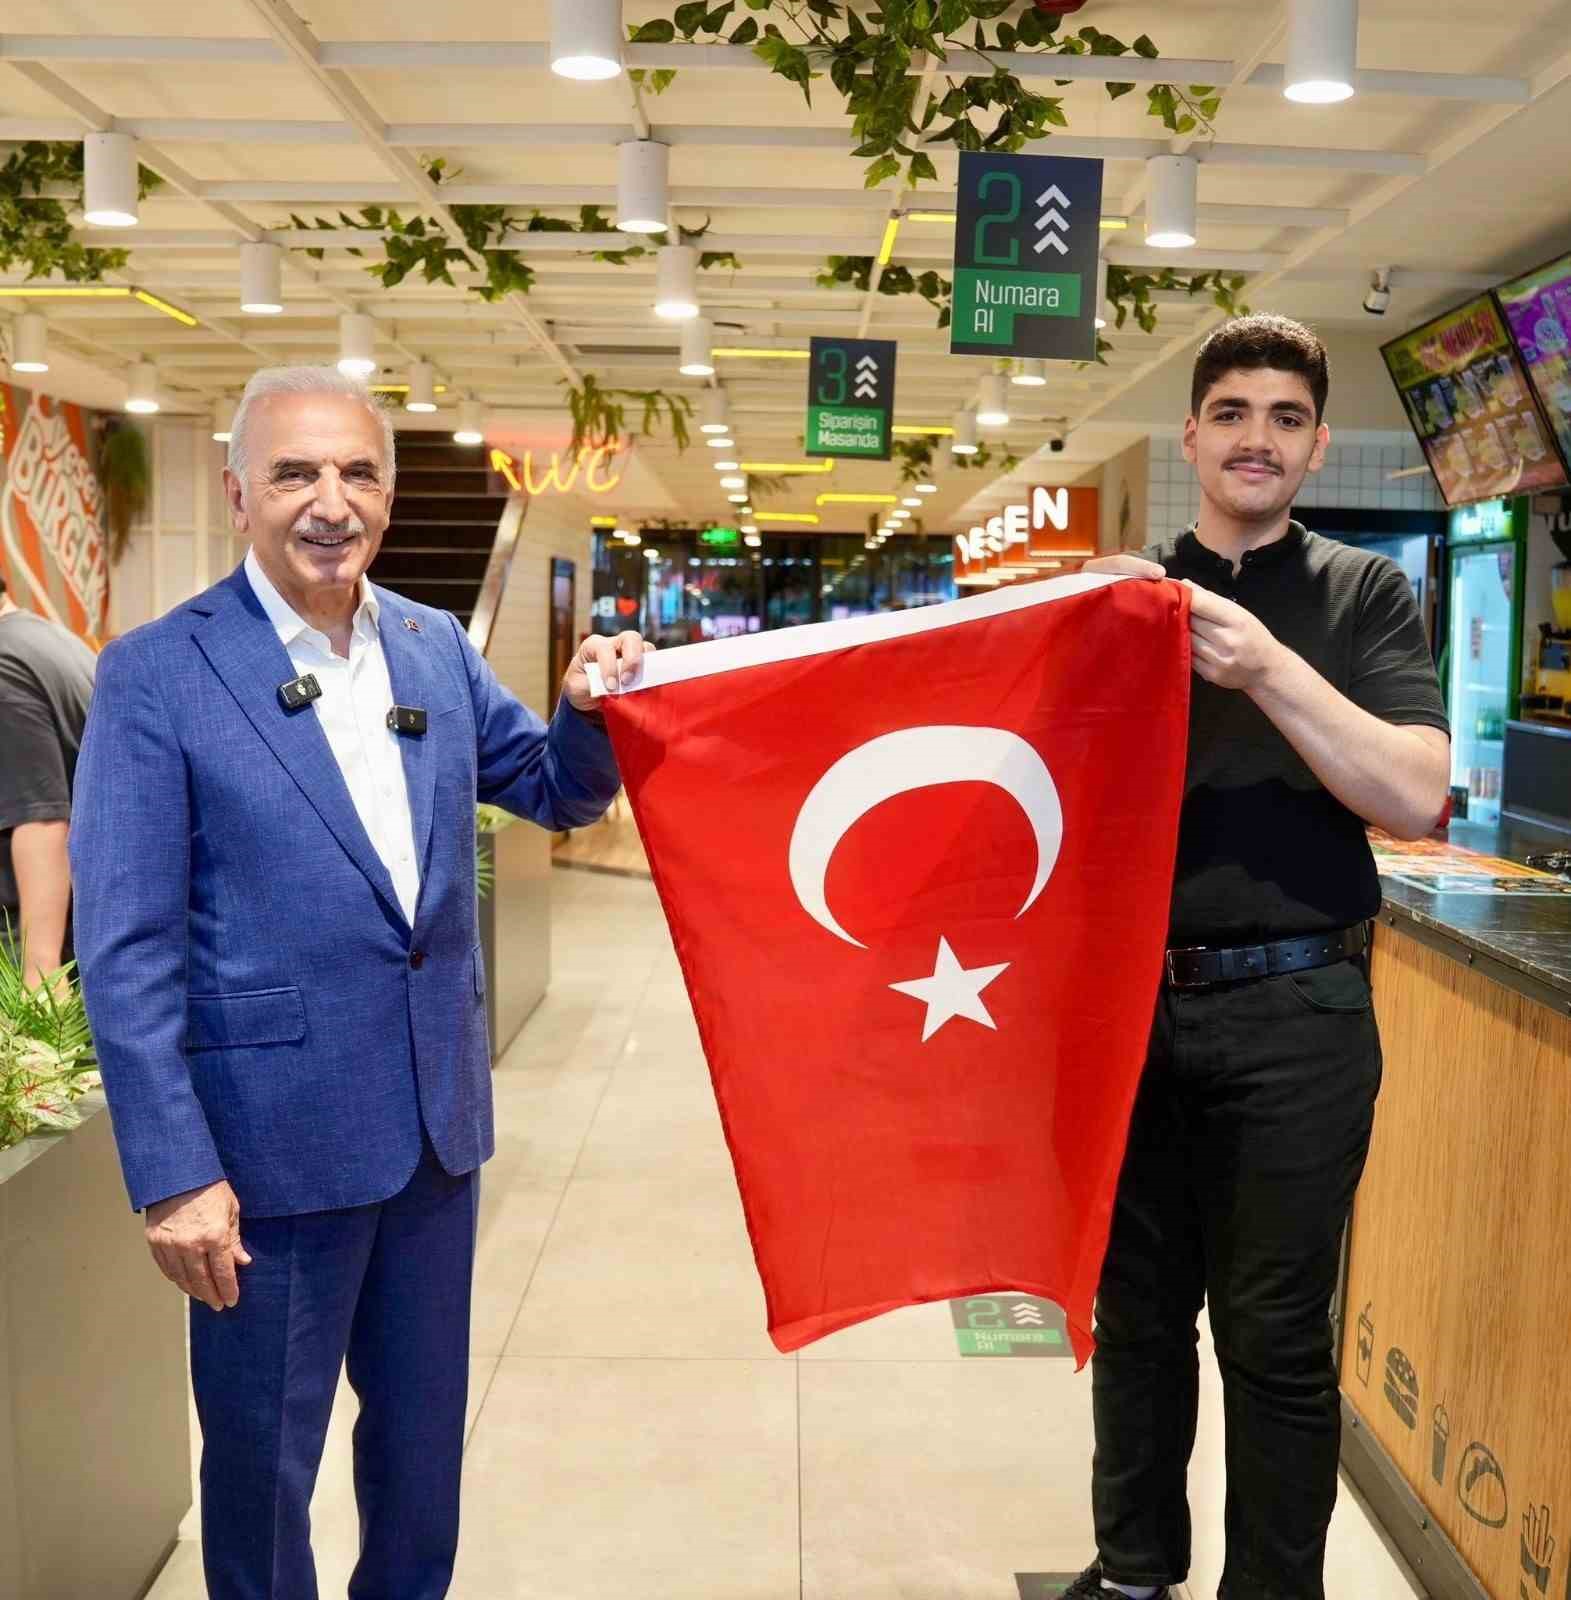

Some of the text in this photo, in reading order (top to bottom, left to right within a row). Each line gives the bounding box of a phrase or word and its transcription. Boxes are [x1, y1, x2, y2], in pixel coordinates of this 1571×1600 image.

[975, 172, 1022, 265] 2
[975, 280, 1060, 307] Numara
[819, 347, 847, 404] 3
[818, 430, 879, 448] Masanda
[523, 443, 621, 495] WC
[955, 486, 1069, 564] YESEN
[965, 1299, 1007, 1328] 2
[974, 1328, 1044, 1344] Numara
